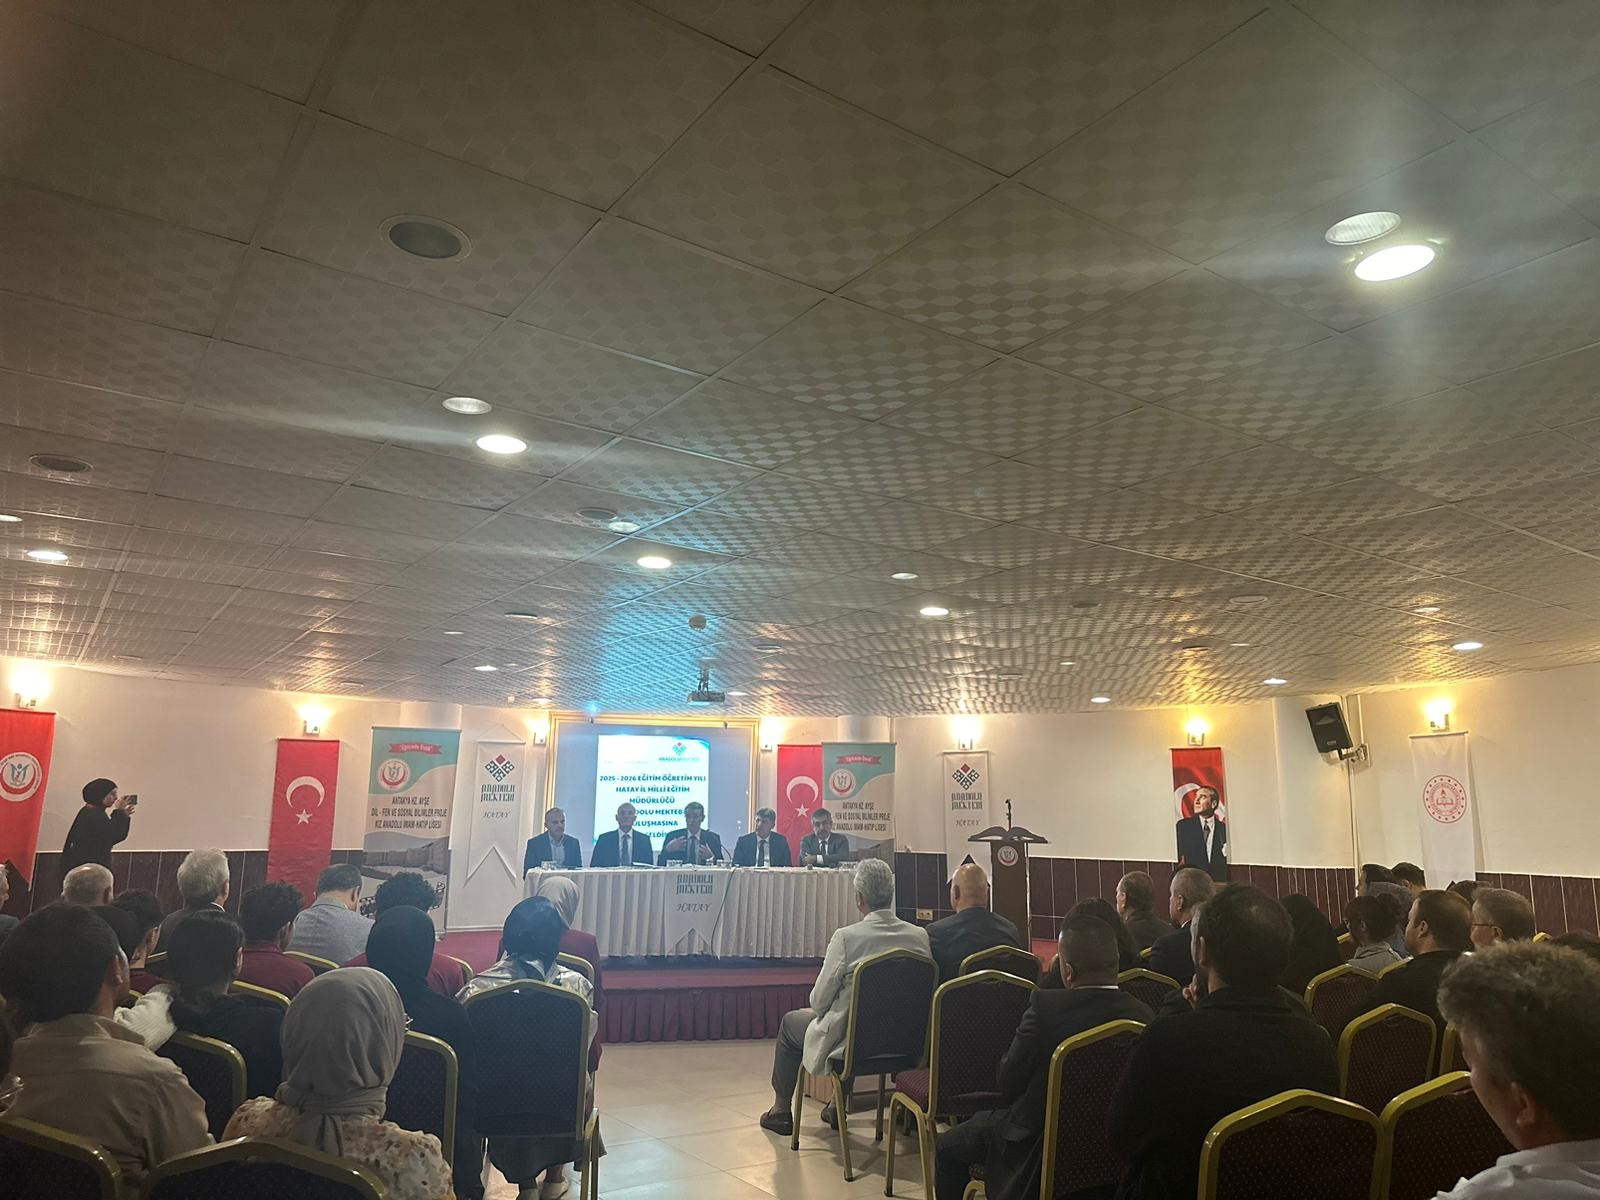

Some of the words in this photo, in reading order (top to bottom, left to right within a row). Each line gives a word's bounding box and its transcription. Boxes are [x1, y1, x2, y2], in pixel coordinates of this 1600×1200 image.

[638, 773, 660, 782] EĞİTİM
[662, 773, 692, 782] ÖĞRETİM
[630, 796, 676, 804] MÜDÜRLÜĞÜ
[676, 902, 712, 912] HATAY
